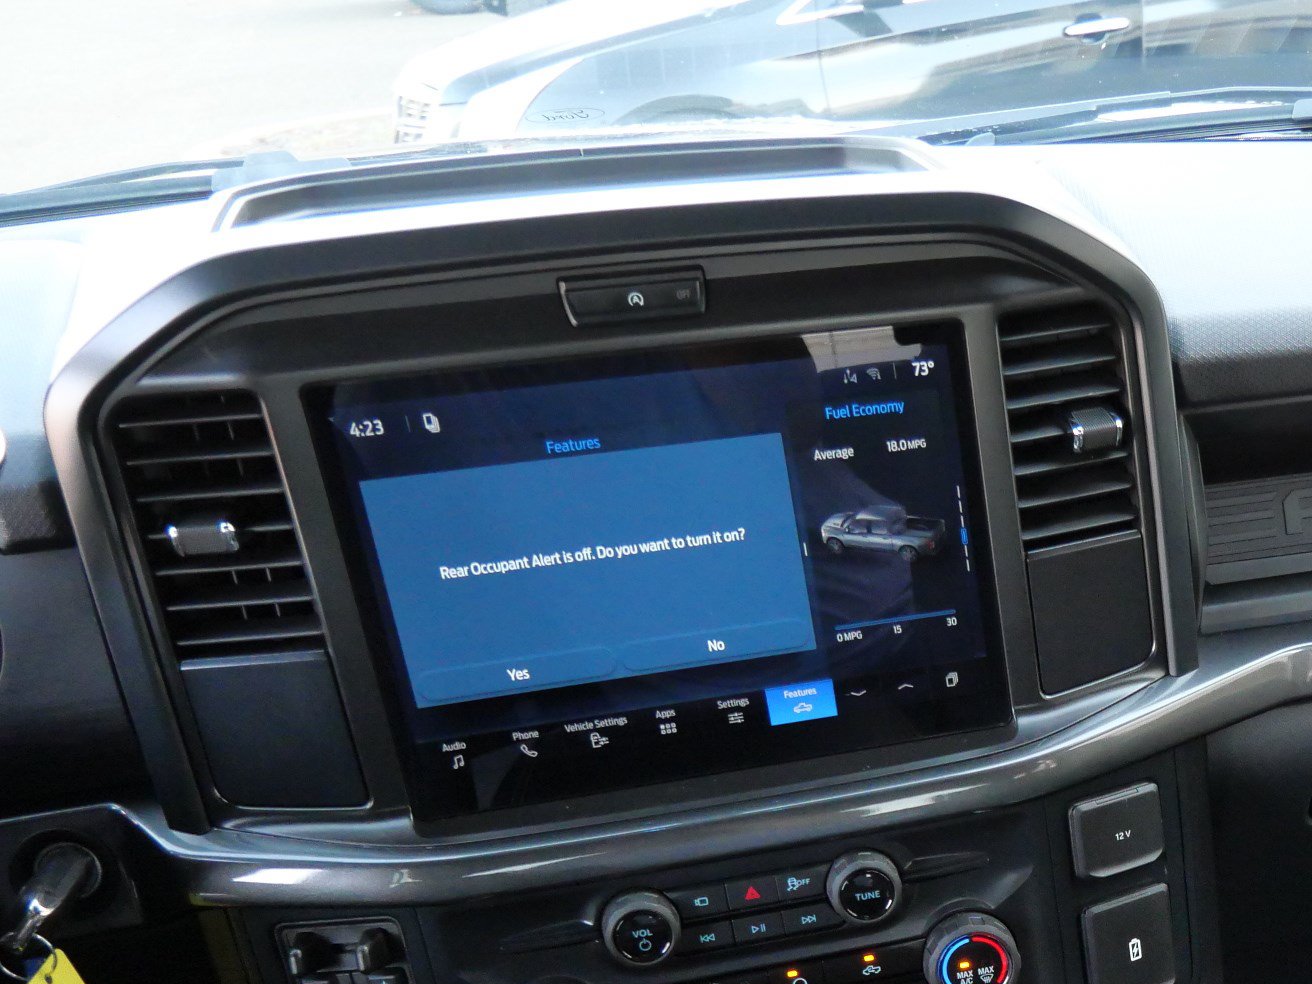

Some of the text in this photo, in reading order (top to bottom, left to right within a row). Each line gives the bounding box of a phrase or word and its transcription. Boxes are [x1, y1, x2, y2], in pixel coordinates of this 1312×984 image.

[825, 401, 905, 420] Fuel Economy
[350, 419, 384, 437] 4:23
[546, 436, 601, 454] Features
[813, 438, 927, 461] Average 18.0 MPG
[439, 527, 746, 580] Rear Occupant Alert is off. Do you want to turn it on?
[946, 617, 957, 627] 30
[893, 625, 902, 634] 15
[844, 631, 863, 641] MPG
[707, 639, 725, 652] No
[507, 668, 530, 681] Yes
[783, 687, 817, 699] Features
[717, 697, 750, 710] Settings
[655, 709, 676, 720] Apps
[564, 716, 628, 734] Vehicle Settings
[512, 730, 539, 741] Phone
[442, 741, 466, 752] Audio
[1115, 830, 1132, 841] 12 V
[797, 878, 811, 887] OFF
[855, 890, 881, 901] TUNE
[632, 929, 653, 938] VOL
[956, 970, 974, 979] MAX
[977, 966, 994, 975] MAX
